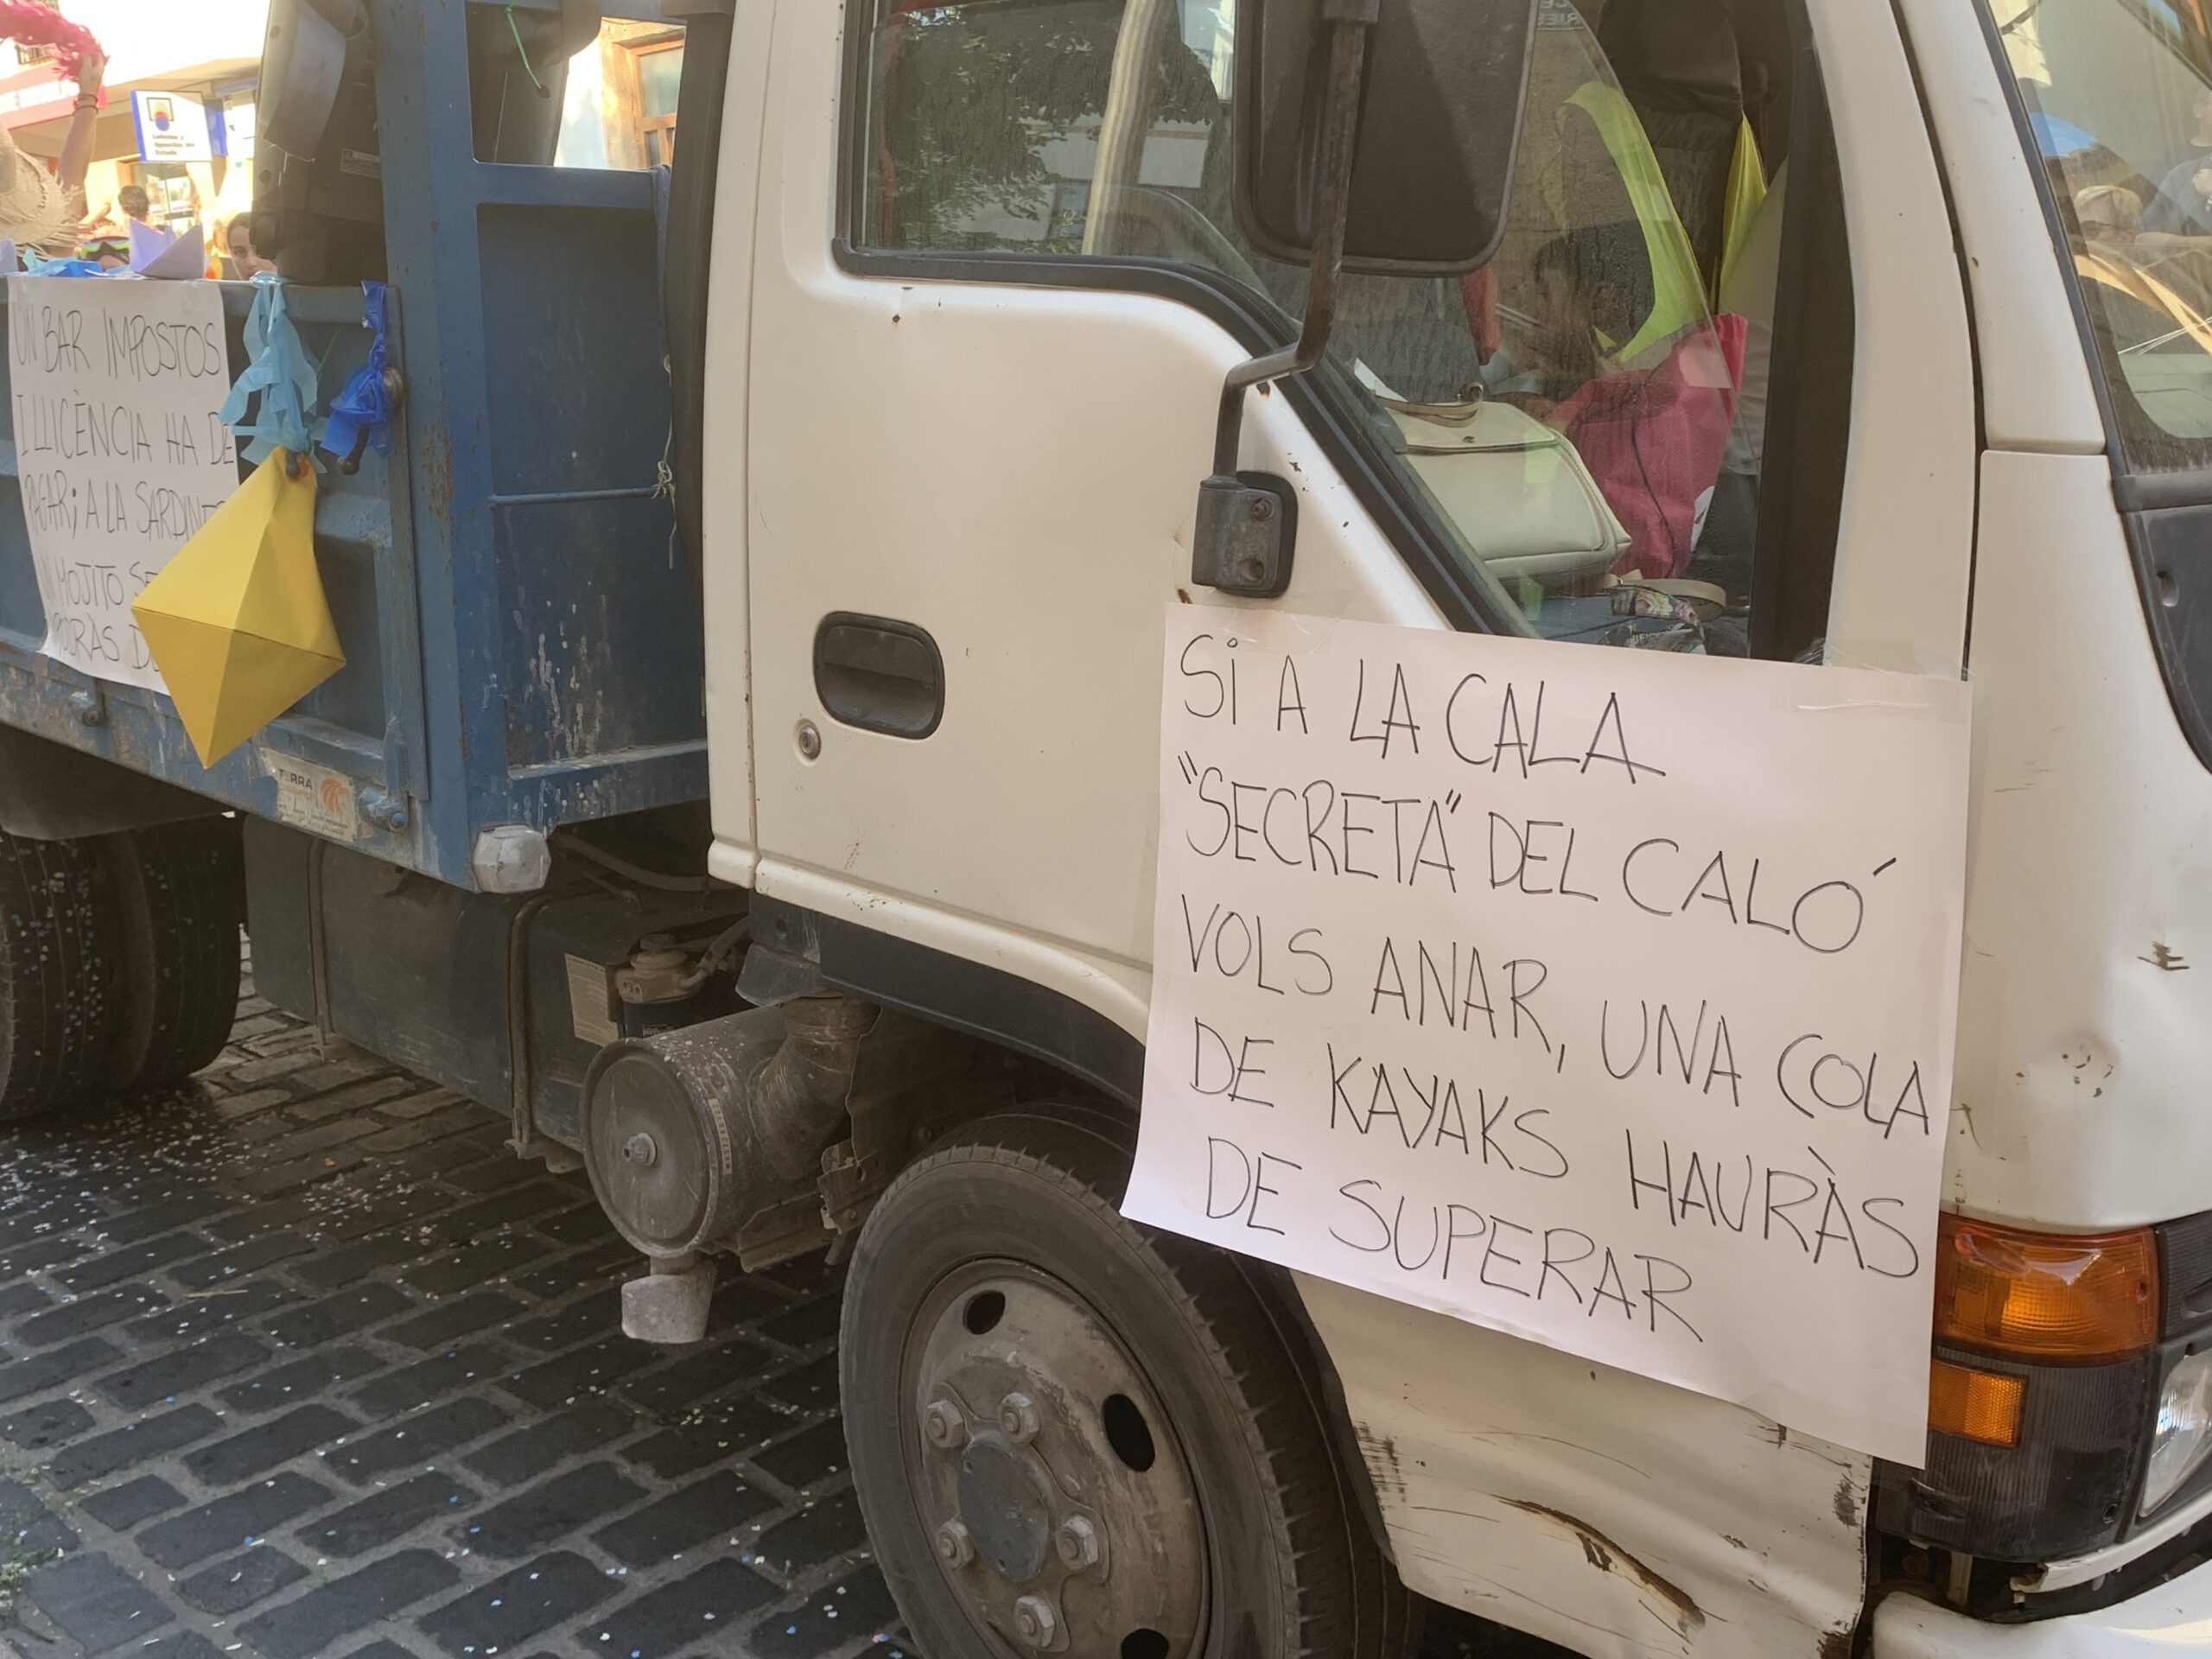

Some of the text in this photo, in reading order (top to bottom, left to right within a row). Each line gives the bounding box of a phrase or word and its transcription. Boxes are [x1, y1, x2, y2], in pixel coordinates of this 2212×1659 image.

[41, 305, 91, 373] BAR
[103, 307, 221, 382] IMPOSTOS
[86, 478, 100, 531] A
[105, 480, 128, 534] LA
[165, 412, 200, 467] HA
[1276, 654, 1309, 734] A
[1350, 658, 1421, 760] LA
[1446, 672, 1667, 785] CALA
[1488, 810, 1599, 903] DEL
[1623, 837, 1897, 954] CALÓ
[1181, 893, 1334, 996] VOLS
[1600, 999, 1743, 1108] UNA
[1777, 1033, 1929, 1139] COLA
[1189, 1016, 1919, 1279] DE KAYAKS HAURÀS
[1205, 1135, 1704, 1344] DE SUPERAR
